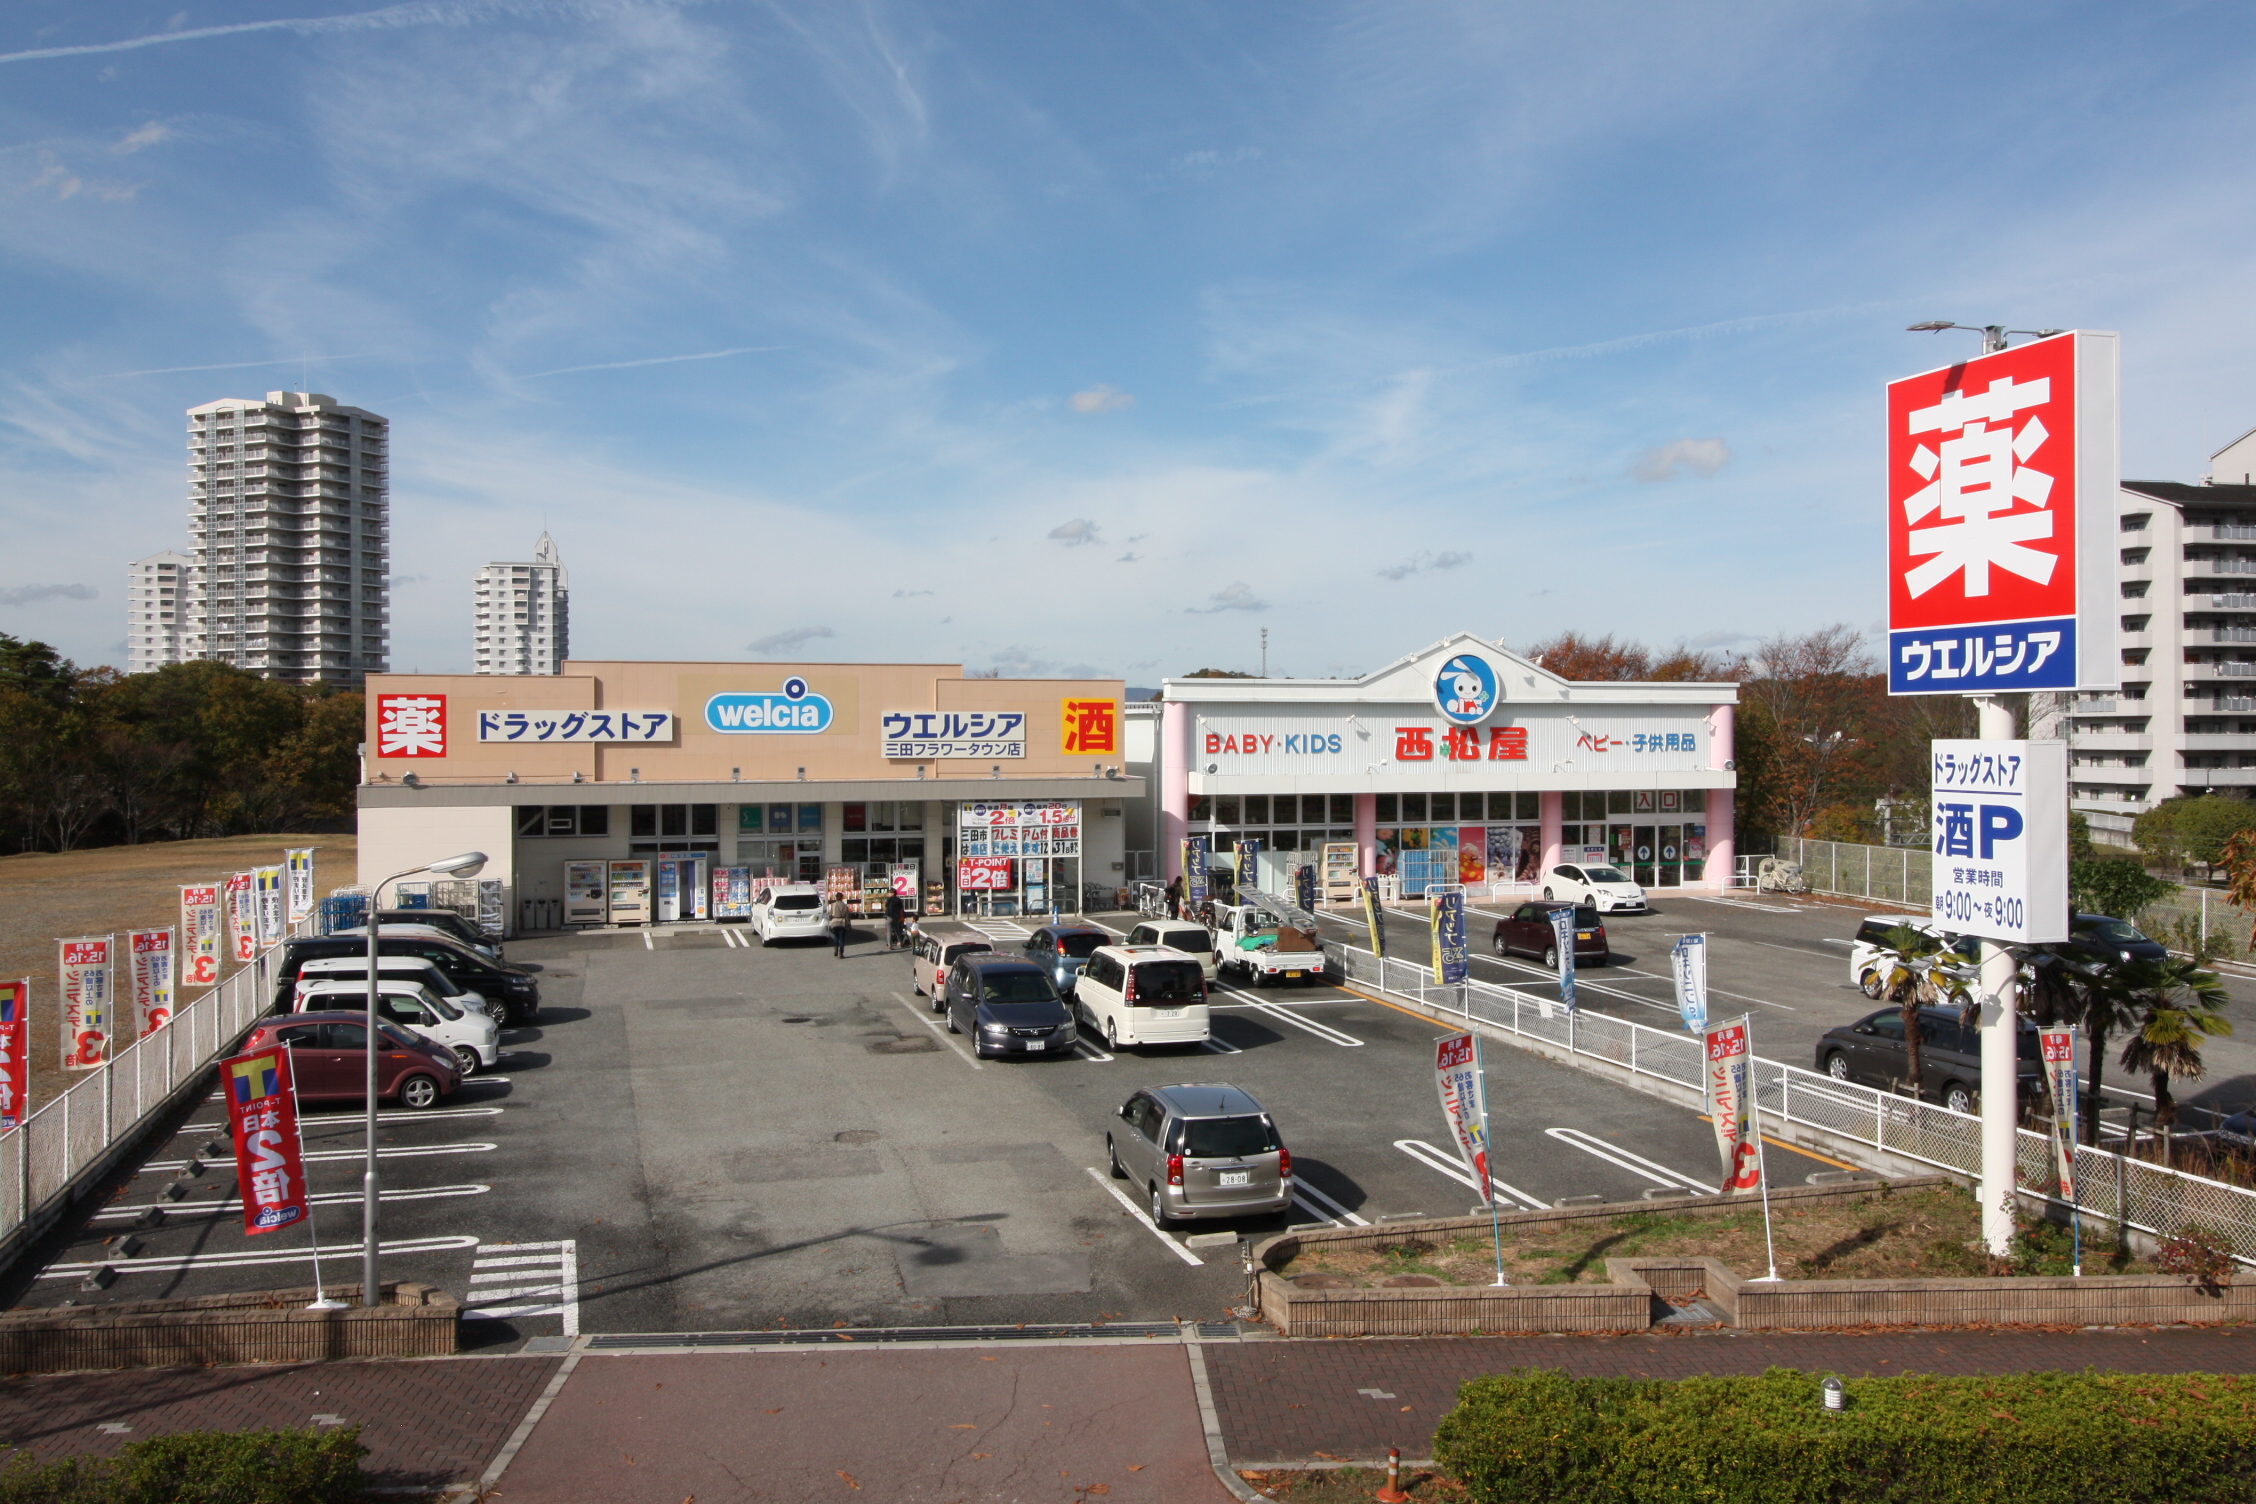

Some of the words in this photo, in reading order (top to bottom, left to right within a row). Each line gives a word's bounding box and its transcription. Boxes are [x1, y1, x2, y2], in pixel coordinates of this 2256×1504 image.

[1903, 376, 2058, 599] 薬
[1901, 632, 2061, 681] ウエルシア
[717, 685, 819, 727] welcia
[381, 698, 443, 754] 薬
[480, 712, 668, 740] ドラッグストア
[883, 713, 1022, 739] ウエルシア
[1065, 701, 1114, 751] 酒
[885, 743, 1020, 756] 三田フラワータウン店
[1395, 727, 1528, 760] 西松屋
[1935, 752, 2021, 787] ドラッグストア
[1638, 793, 1675, 807] 入口
[970, 858, 1008, 866] T-POINT
[962, 869, 970, 887] 本日
[971, 867, 1008, 888] 2倍
[1953, 867, 2003, 888] 営業時間
